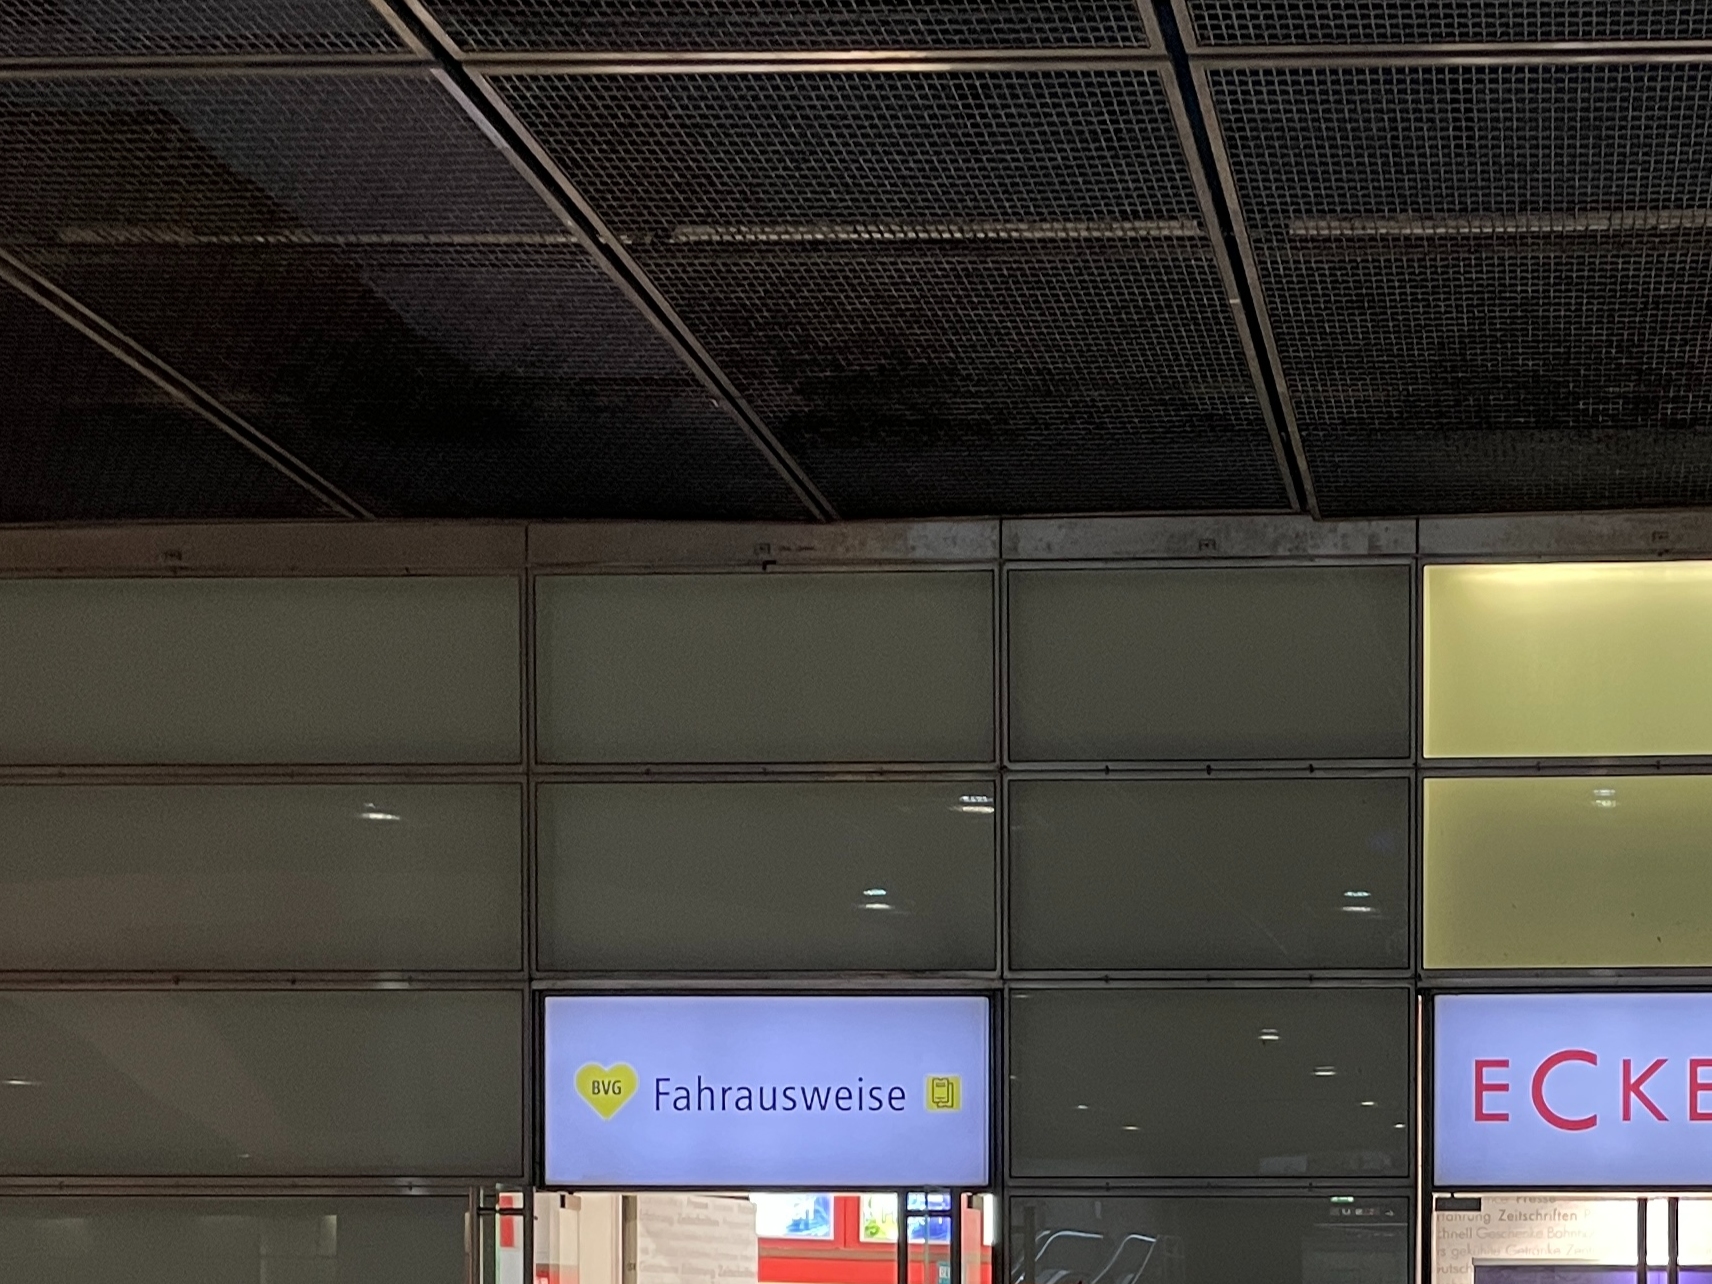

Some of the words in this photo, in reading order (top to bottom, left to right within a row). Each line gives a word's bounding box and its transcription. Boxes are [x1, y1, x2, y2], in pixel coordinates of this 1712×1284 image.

[591, 1080, 622, 1096] BVG
[654, 1075, 906, 1112] Fahrausweise
[1498, 1208, 1578, 1222] Zeitschriften
